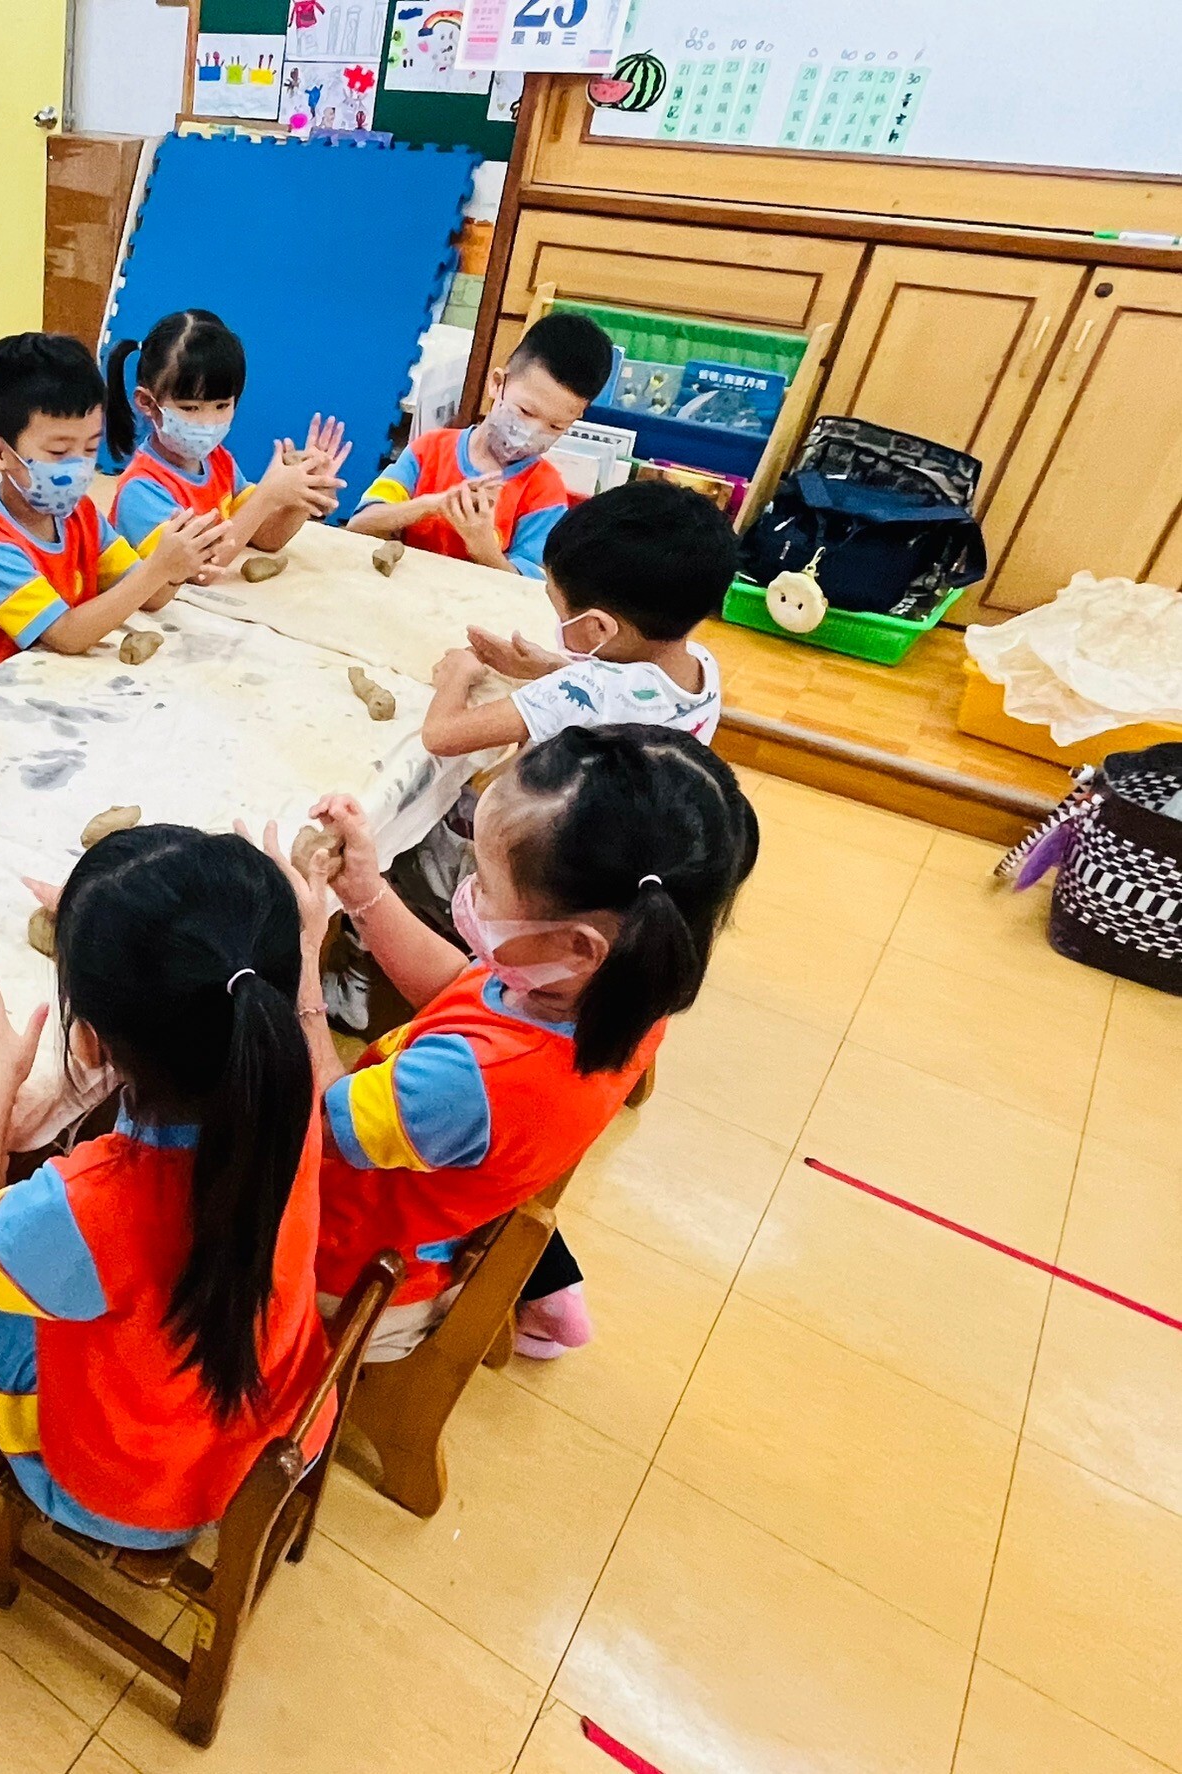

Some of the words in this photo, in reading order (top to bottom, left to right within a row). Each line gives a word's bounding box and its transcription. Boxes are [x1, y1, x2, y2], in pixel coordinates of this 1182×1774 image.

[510, 31, 578, 45] 星期三
[701, 63, 716, 75] 22
[725, 61, 740, 73] 23
[833, 70, 849, 83] 27
[858, 70, 874, 82] 28
[880, 71, 896, 83] 29
[906, 72, 922, 85] 30
